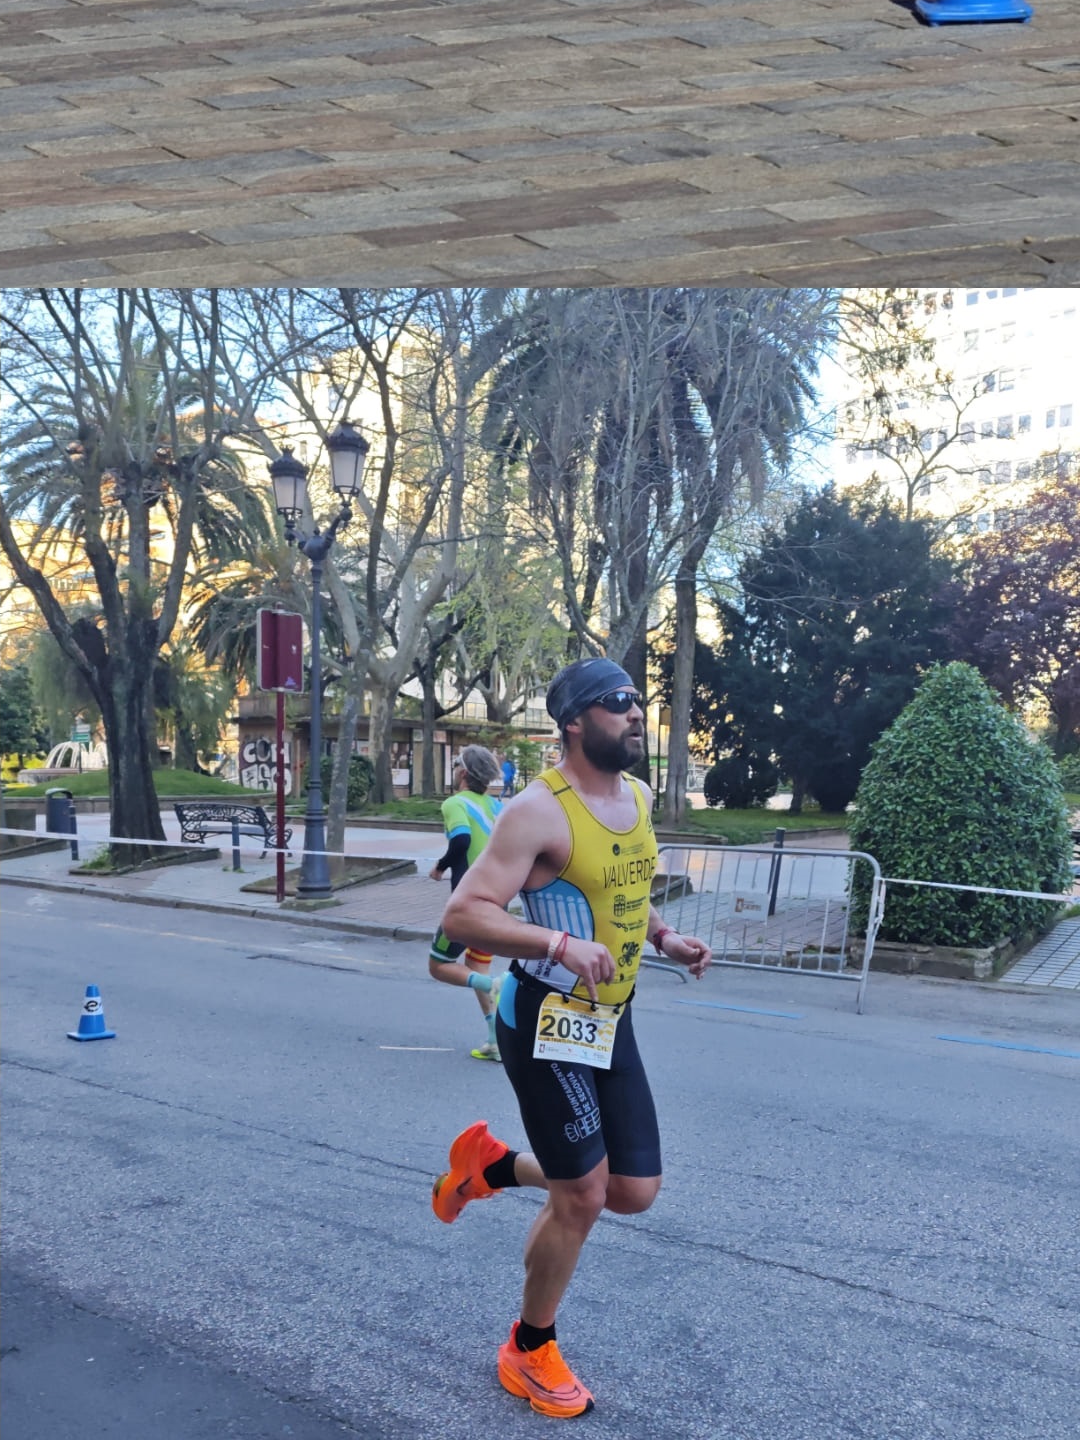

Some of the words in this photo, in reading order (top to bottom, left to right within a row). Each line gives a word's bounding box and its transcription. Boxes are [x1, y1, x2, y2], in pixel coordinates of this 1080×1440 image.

[603, 856, 657, 889] VALVERDE
[539, 1014, 598, 1044] 2033
[550, 1062, 583, 1116] AYUNTAMIENTO
[565, 1071, 588, 1100] SEGOVIA
[582, 1100, 591, 1113] DE
